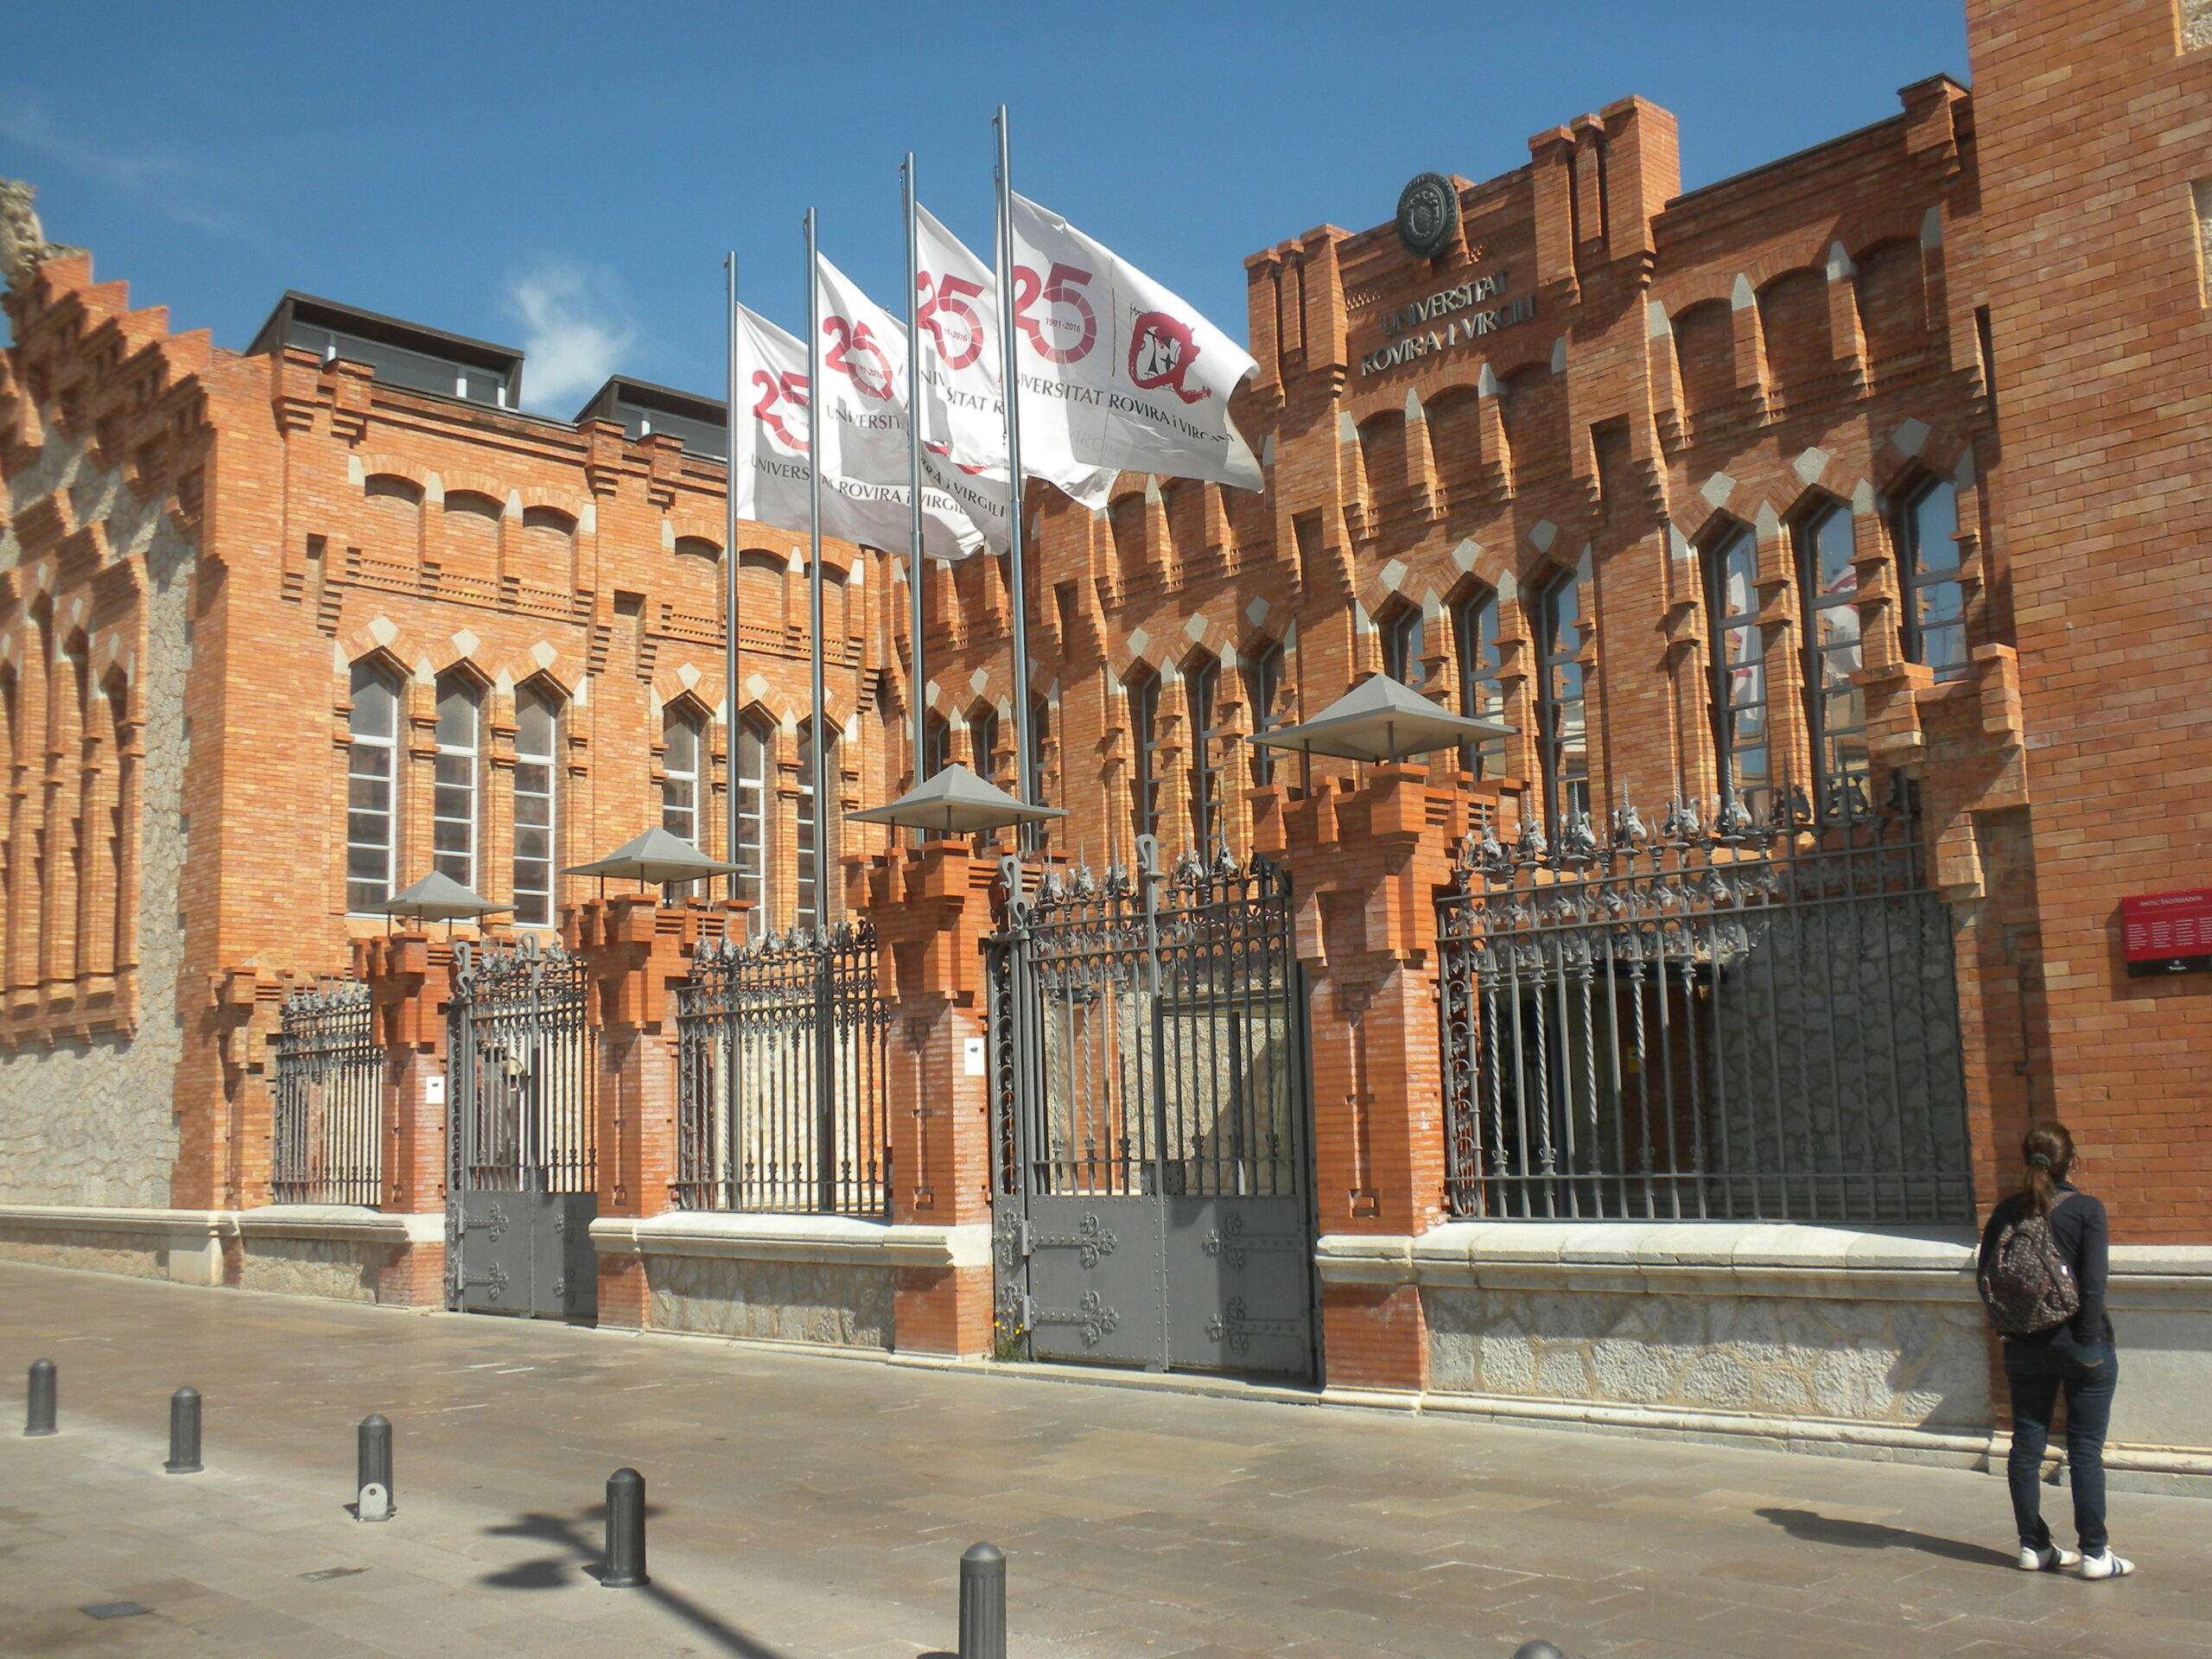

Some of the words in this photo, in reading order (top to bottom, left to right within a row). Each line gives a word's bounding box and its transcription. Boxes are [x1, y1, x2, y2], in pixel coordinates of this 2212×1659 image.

[1382, 270, 1510, 335] UNIVERSITAT
[1046, 318, 1080, 333] 1991-2016
[1362, 331, 1441, 376] ROVIRA
[1447, 323, 1456, 346] I
[1461, 296, 1535, 339] VIRGILI
[1109, 394, 1170, 425] ROVIRA
[1172, 415, 1177, 428] i
[839, 480, 901, 504] ROVIRA
[906, 491, 912, 505] i
[953, 482, 1005, 518] VIRGILI
